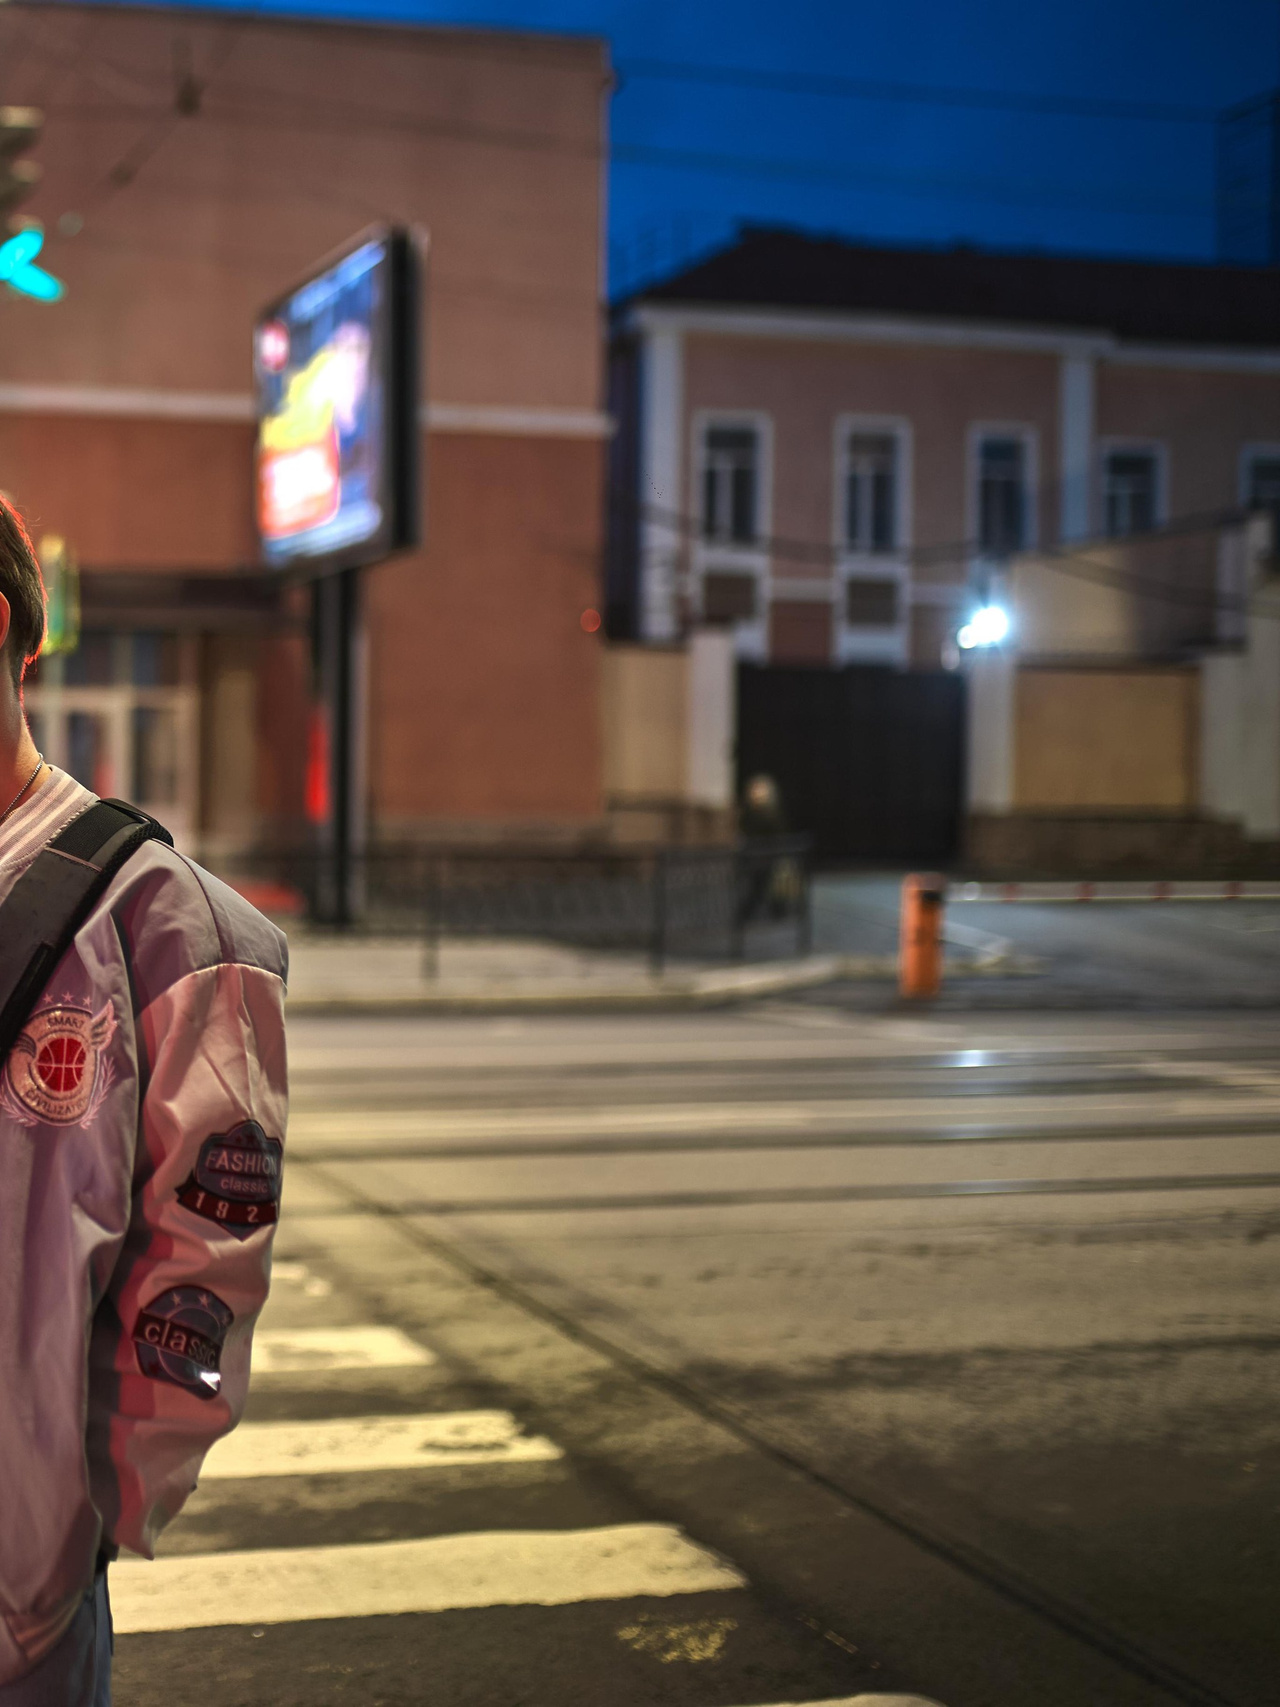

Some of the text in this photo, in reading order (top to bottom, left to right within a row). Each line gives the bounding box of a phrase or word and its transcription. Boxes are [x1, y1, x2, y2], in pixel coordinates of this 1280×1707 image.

[47, 1016, 85, 1029] SMART
[204, 1149, 278, 1176] FASHION
[220, 1176, 268, 1194] classic
[144, 1321, 216, 1368] classic
